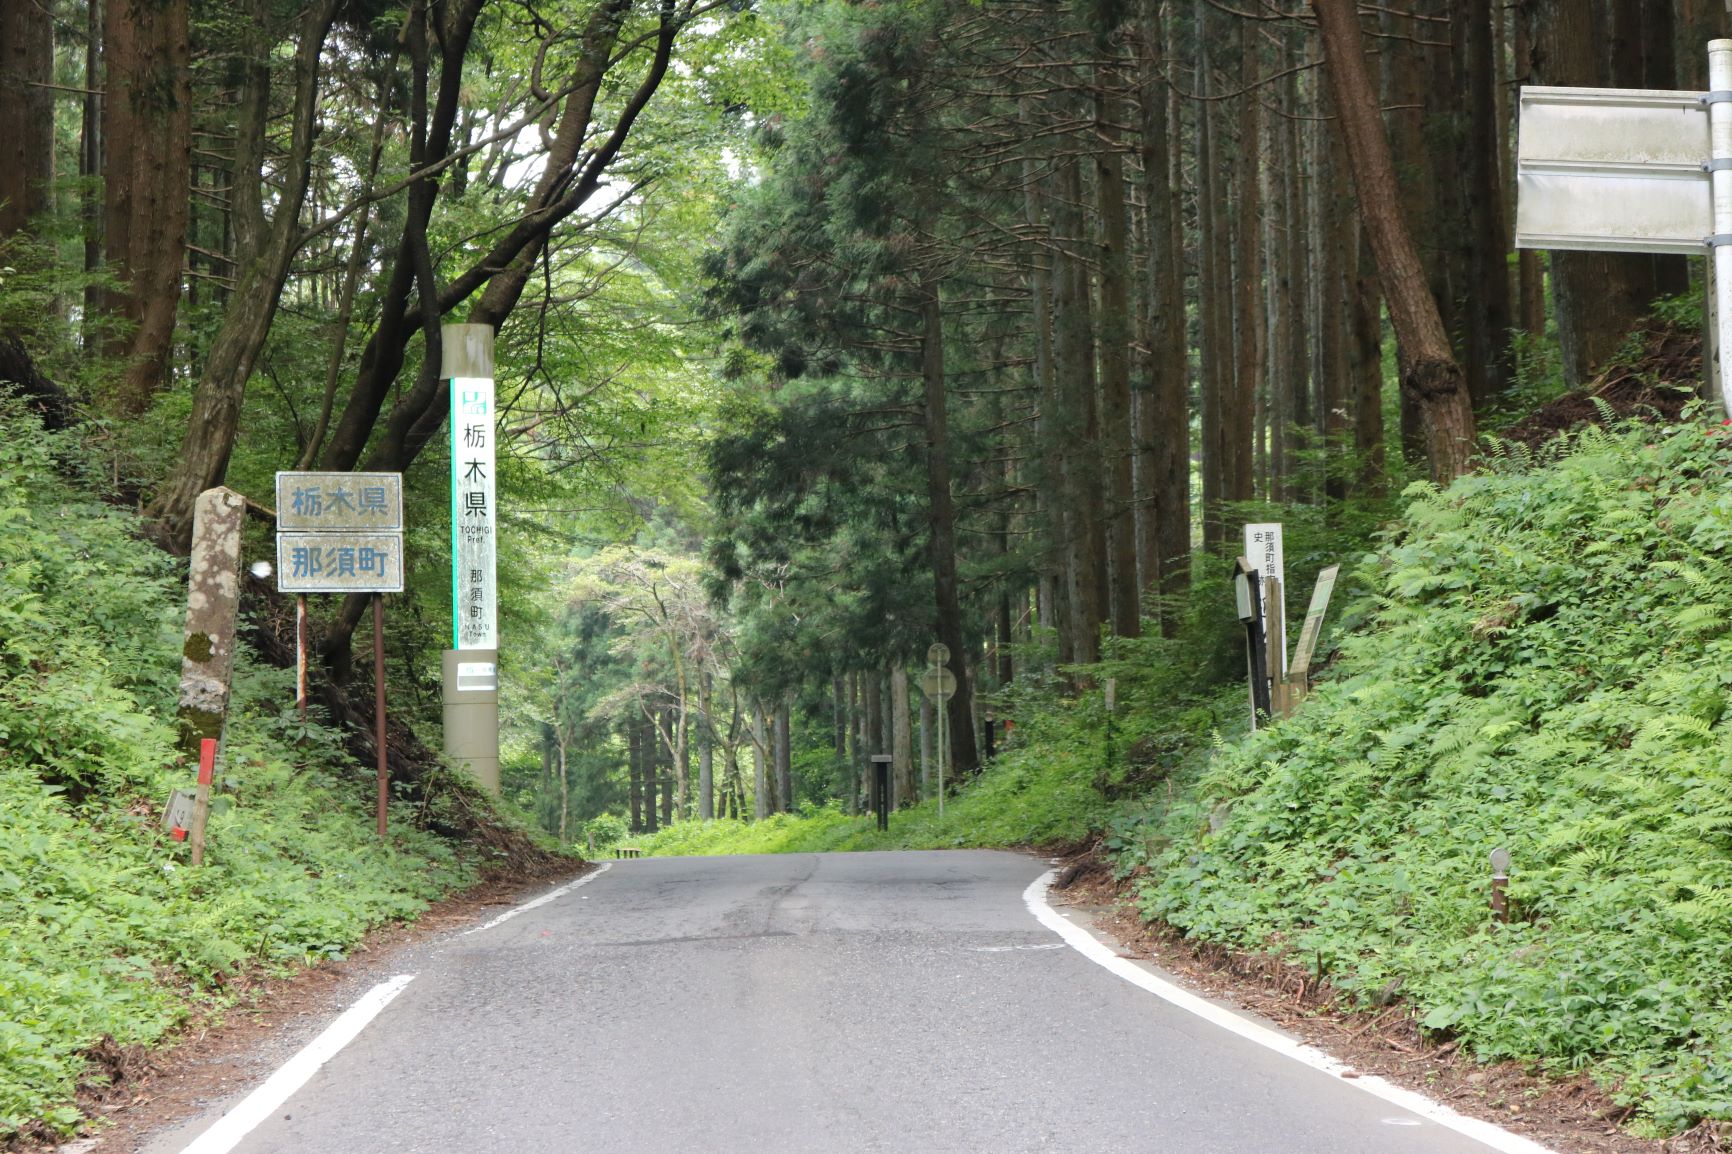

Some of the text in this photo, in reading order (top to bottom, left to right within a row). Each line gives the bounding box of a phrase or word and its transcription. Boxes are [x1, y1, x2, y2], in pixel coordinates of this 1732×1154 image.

[464, 423, 486, 517] 栃木県
[291, 486, 389, 517] 栃木県
[460, 526, 493, 534] TOCHIGI
[467, 536, 485, 544] Pref.
[291, 547, 389, 578] 那須町
[1265, 531, 1275, 577] 那須町指
[470, 569, 483, 620] 那須町
